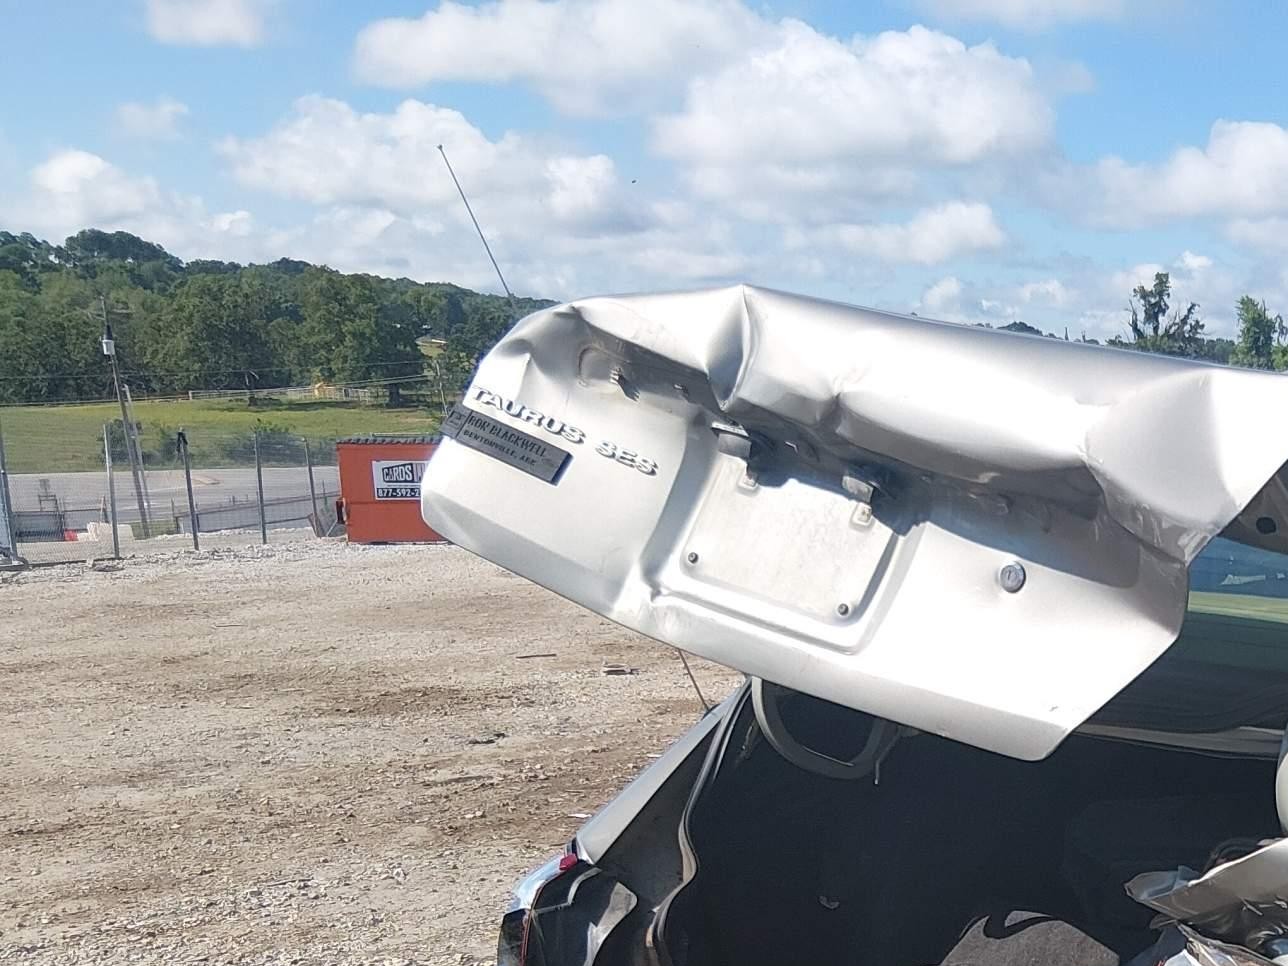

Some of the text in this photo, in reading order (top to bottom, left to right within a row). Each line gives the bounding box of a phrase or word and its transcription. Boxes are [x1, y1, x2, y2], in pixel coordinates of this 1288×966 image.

[472, 386, 587, 445] TAURUS
[595, 438, 660, 476] SES
[488, 424, 547, 458] BLACKWELL
[383, 464, 413, 481] CARDS
[378, 488, 421, 497] 877-592-2
